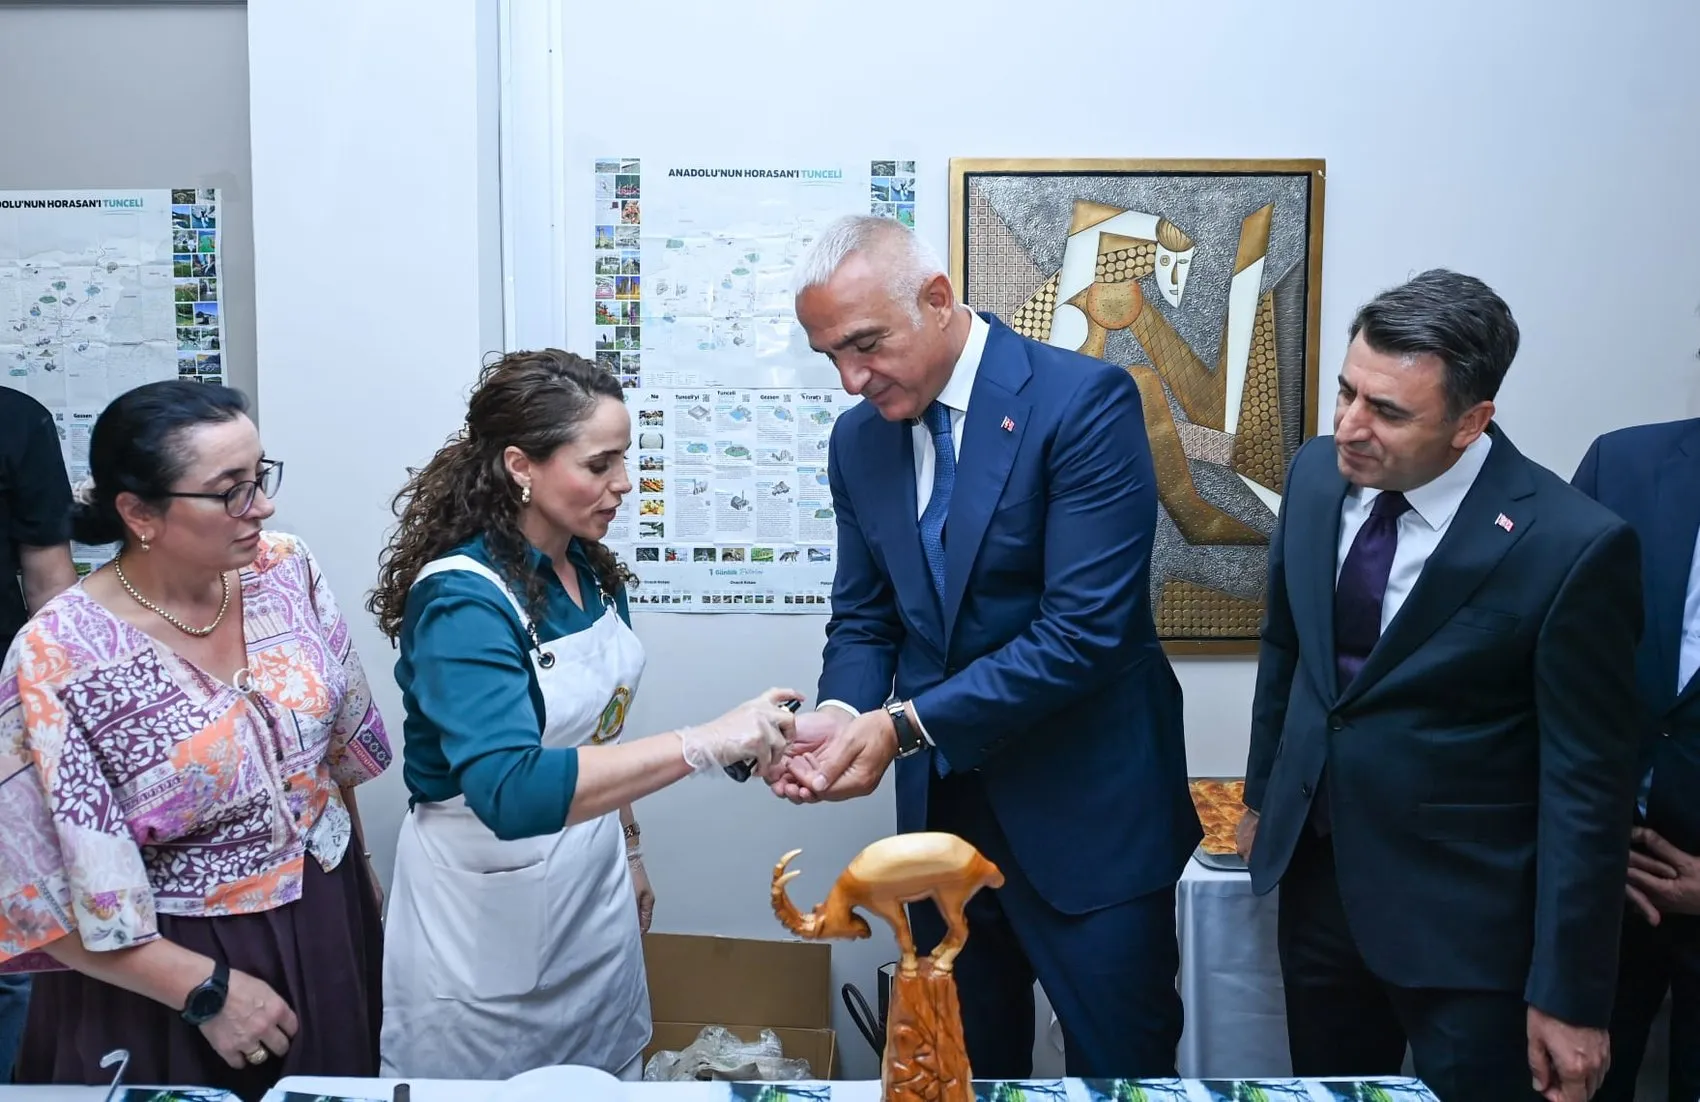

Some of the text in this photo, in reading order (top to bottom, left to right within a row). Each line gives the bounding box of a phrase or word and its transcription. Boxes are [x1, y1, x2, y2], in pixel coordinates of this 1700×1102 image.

[668, 168, 843, 179] ANADOLU'NUN HORASAN'I TUNCELİ
[0, 197, 144, 209] OLU'NUN HORASAN'I TUNCELİ
